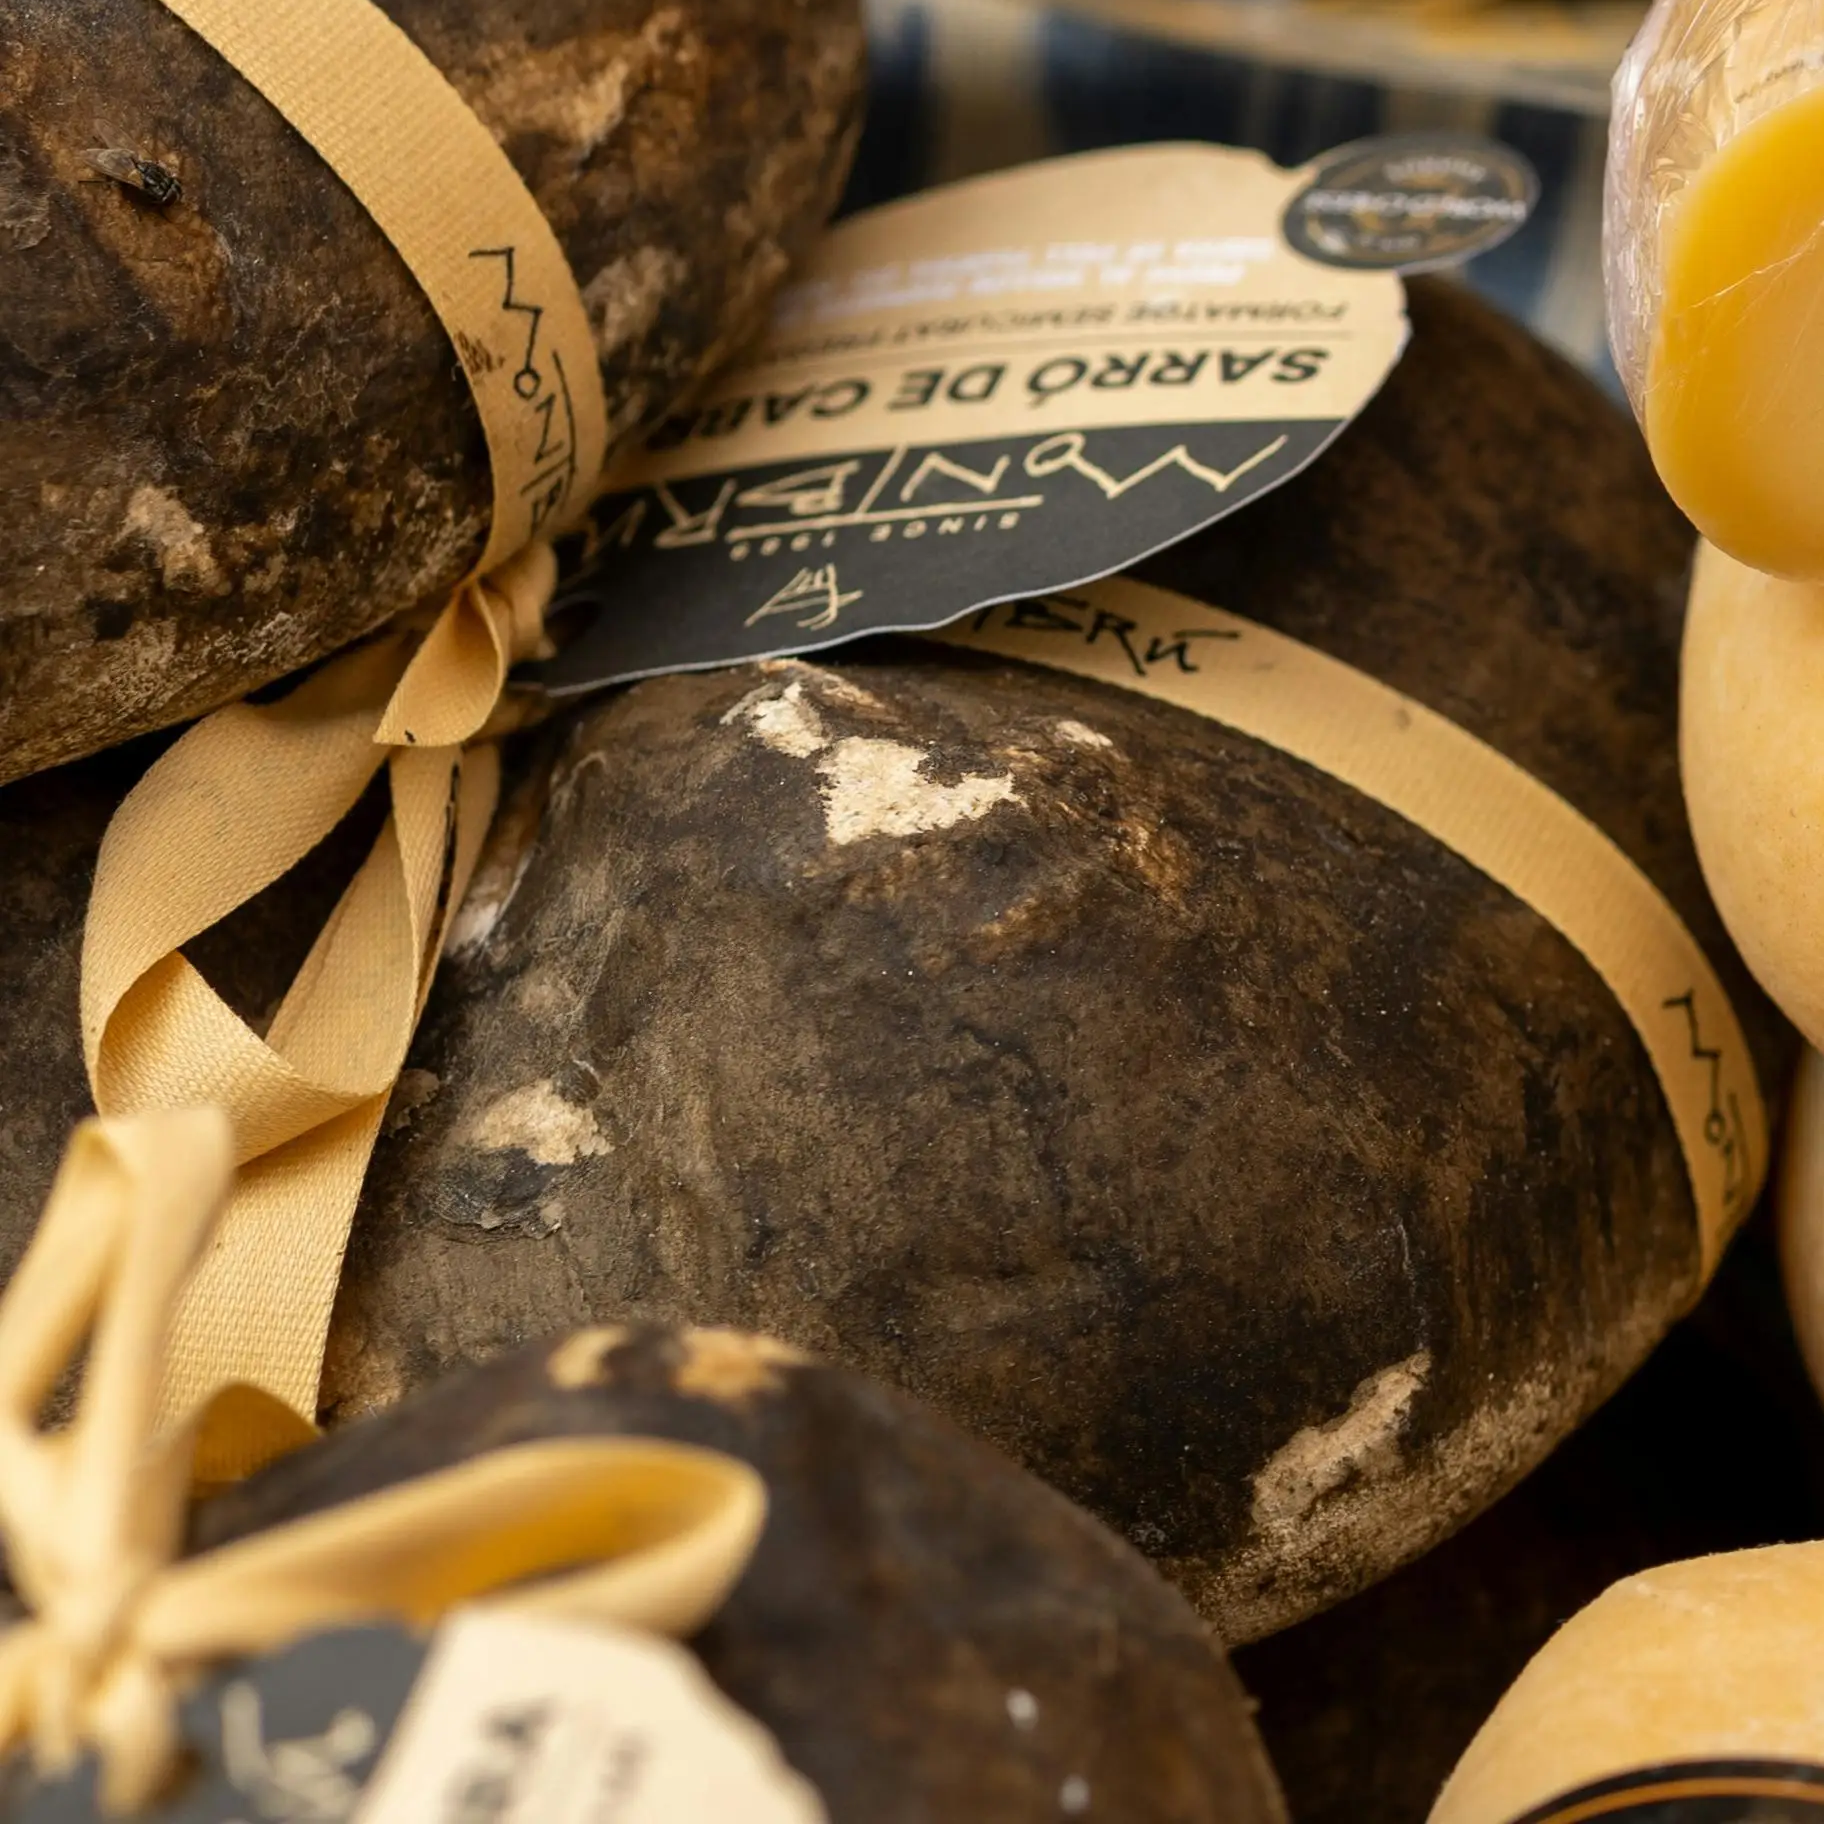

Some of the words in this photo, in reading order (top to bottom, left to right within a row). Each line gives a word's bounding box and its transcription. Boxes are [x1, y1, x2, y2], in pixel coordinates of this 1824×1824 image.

[885, 358, 1009, 415] DE
[1026, 347, 1332, 409] SARRÓ
[869, 512, 1021, 543] SINCE
